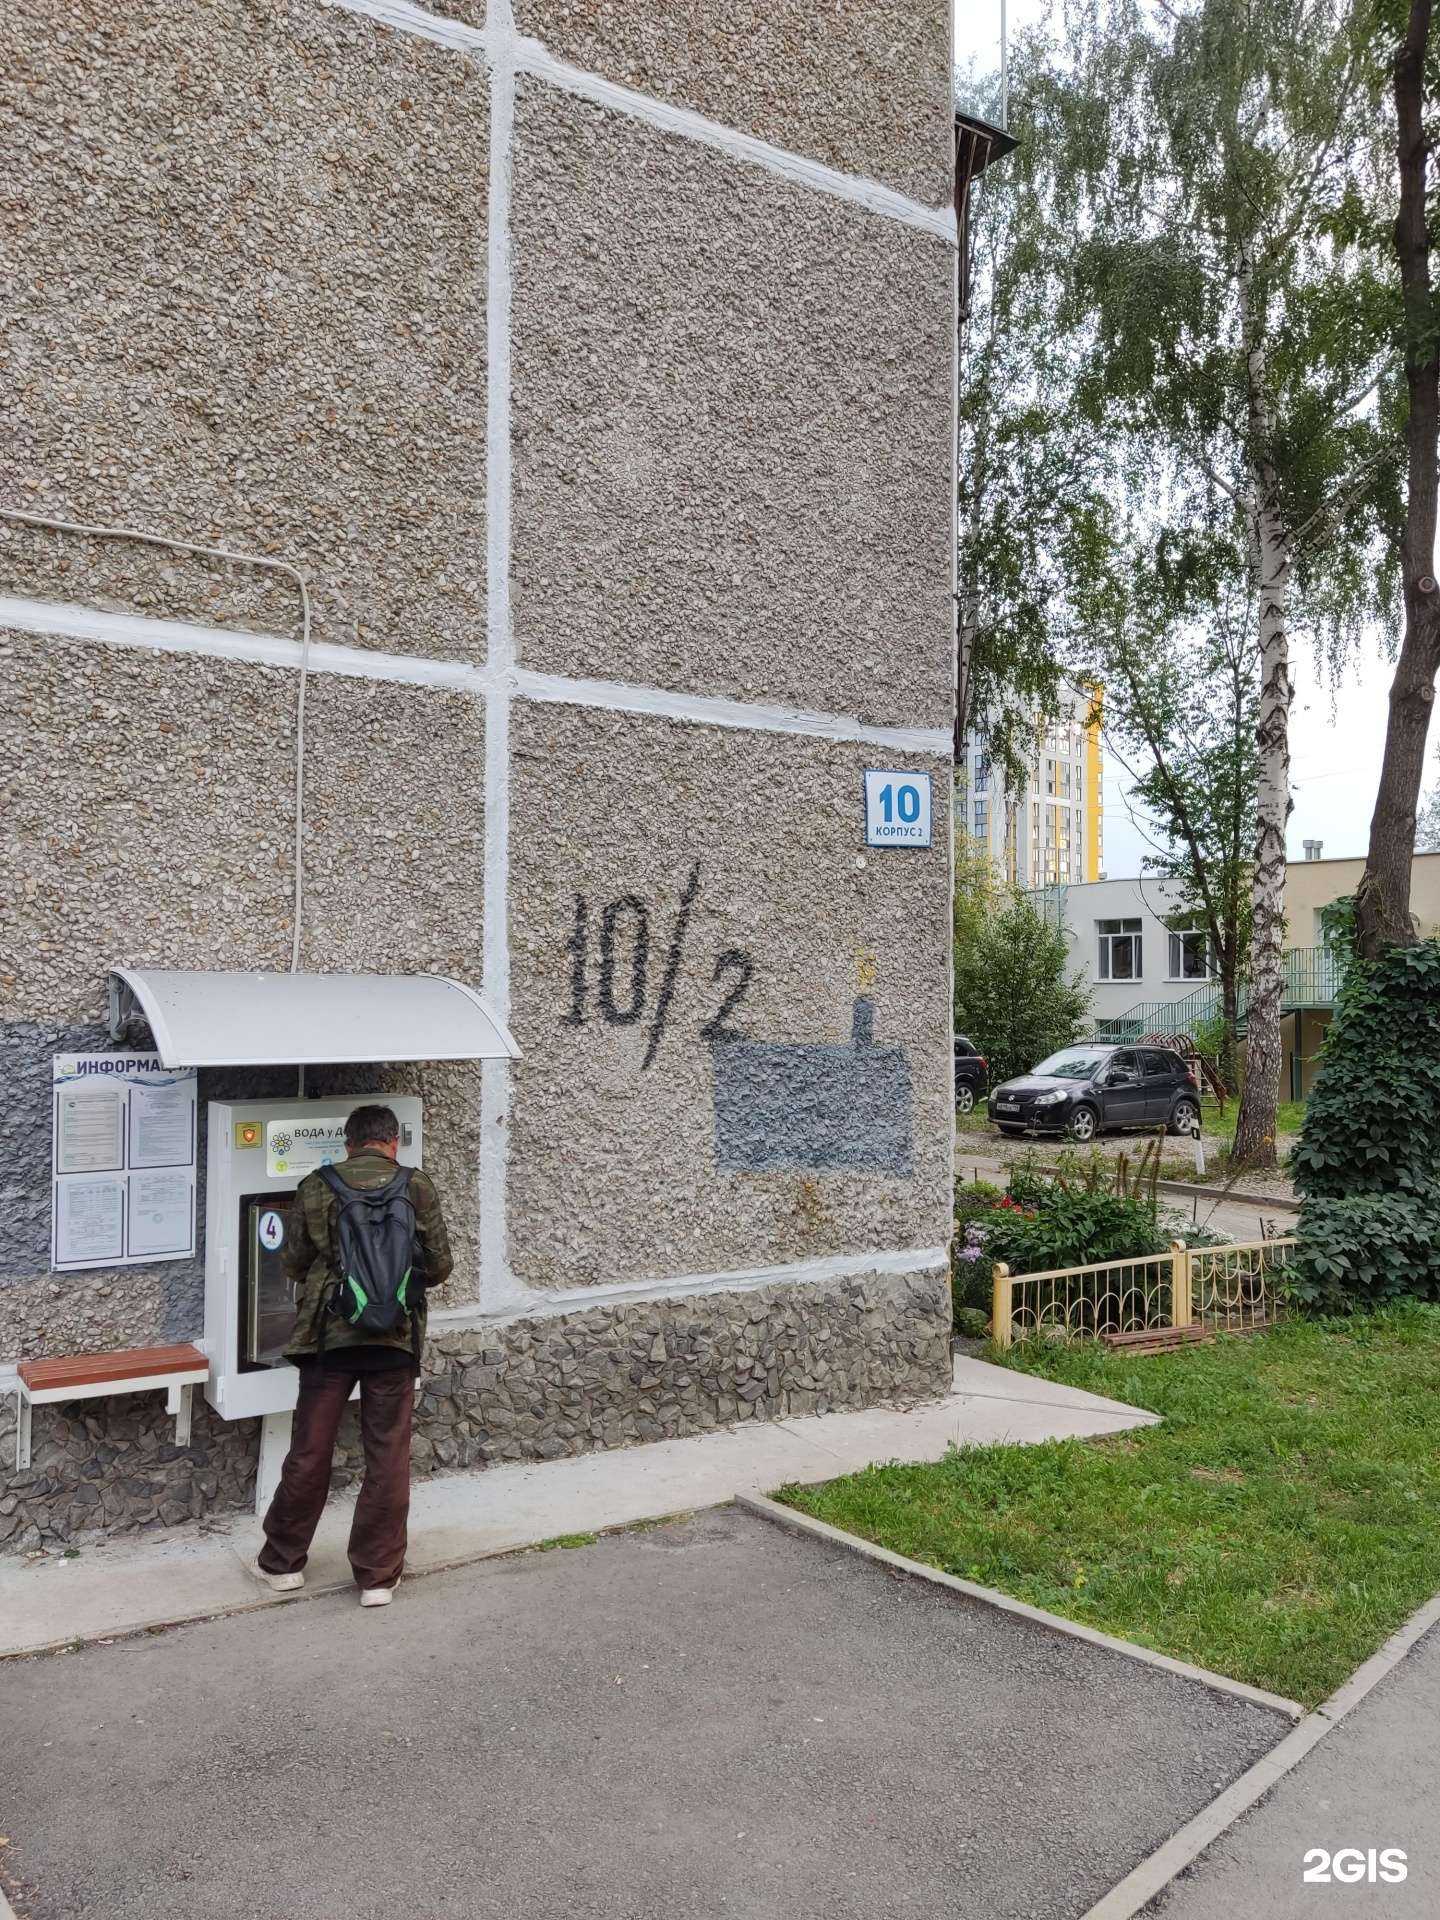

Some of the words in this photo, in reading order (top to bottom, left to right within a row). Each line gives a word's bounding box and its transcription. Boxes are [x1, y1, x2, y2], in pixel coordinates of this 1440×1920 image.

[879, 784, 920, 823] 10
[876, 826, 916, 837] КОРПУС
[76, 1059, 196, 1074] ИНФОРМА
[294, 1128, 325, 1138] ВОДА
[266, 1215, 277, 1239] 4
